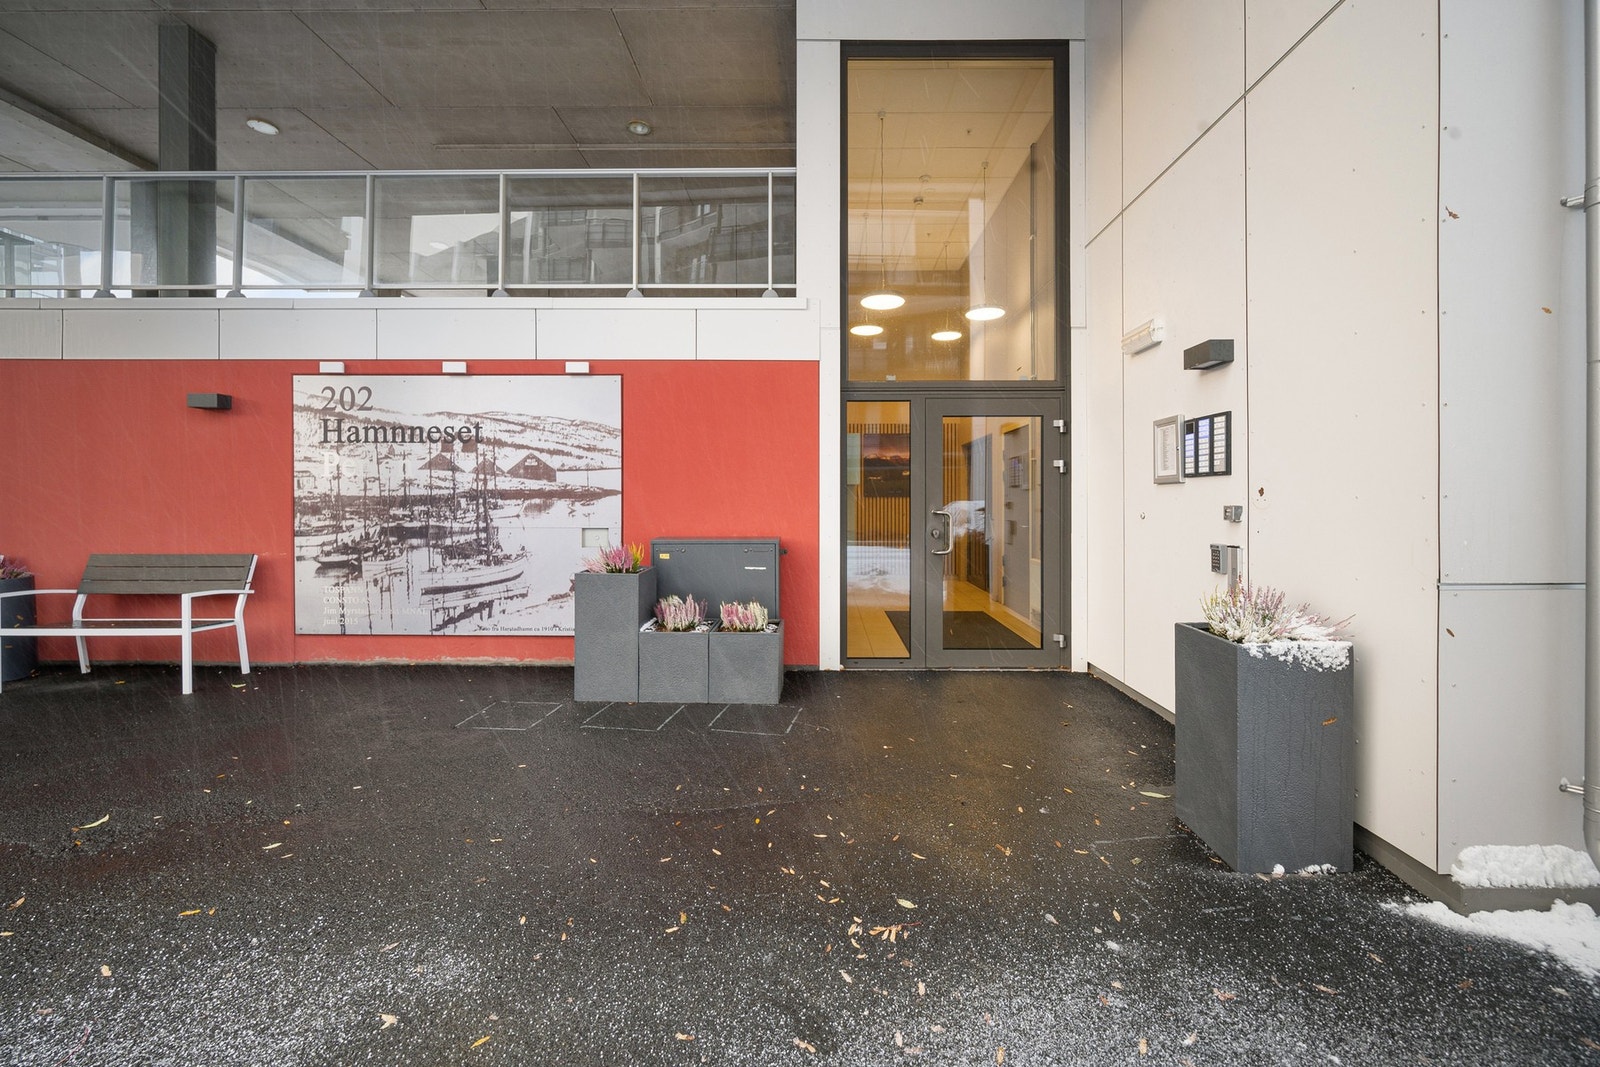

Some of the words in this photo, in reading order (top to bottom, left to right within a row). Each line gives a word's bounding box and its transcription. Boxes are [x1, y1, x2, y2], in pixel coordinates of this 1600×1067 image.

[321, 386, 374, 412] 202
[319, 418, 483, 444] Hamnneset
[339, 617, 359, 625] 2015
